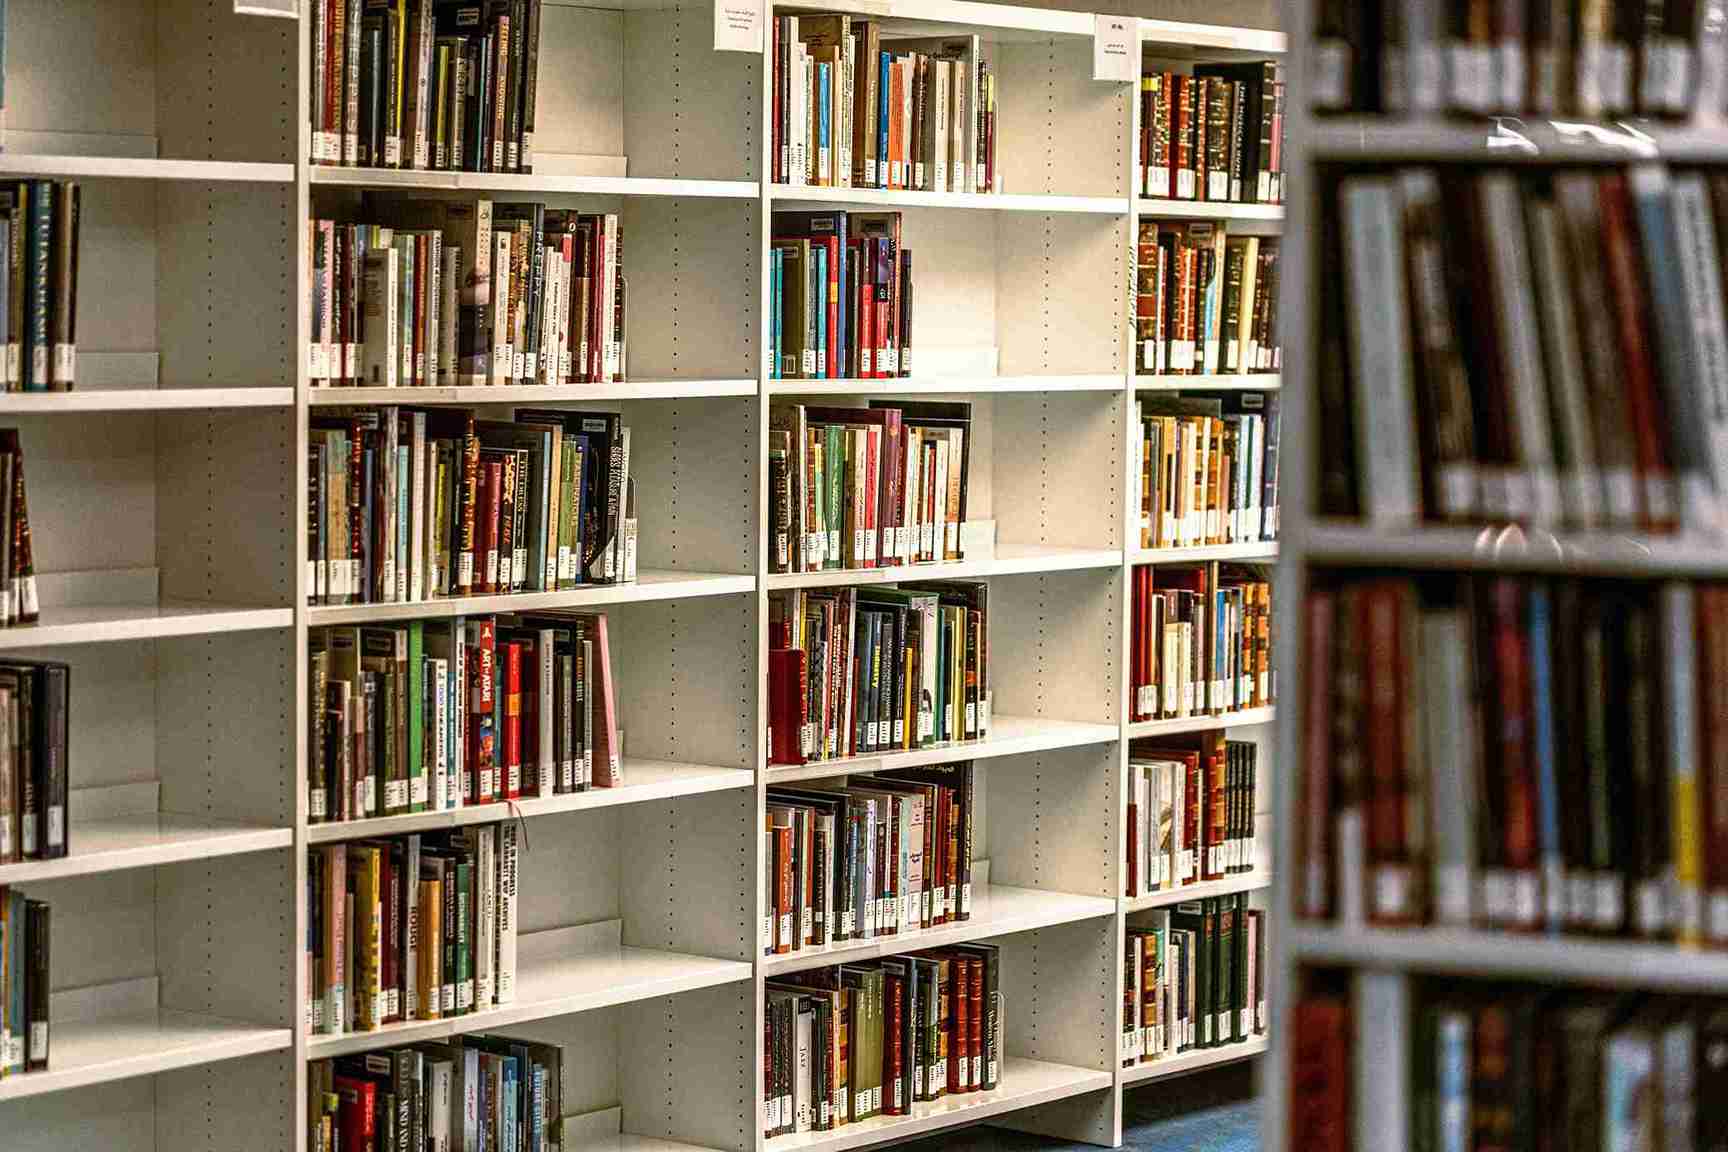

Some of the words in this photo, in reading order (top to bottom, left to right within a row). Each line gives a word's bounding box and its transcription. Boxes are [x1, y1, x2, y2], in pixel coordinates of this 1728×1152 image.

[496, 75, 506, 120] KNOWING
[533, 231, 545, 296] PREPPY
[517, 482, 525, 512] DRESS
[481, 648, 491, 668] ART
[871, 645, 881, 689] Industry
[481, 674, 491, 702] ATARI
[409, 905, 418, 953] ROUGE
[533, 1071, 543, 1103] FUTURE
[399, 1099, 409, 1126] MIND
[399, 1128, 409, 1148] AND
